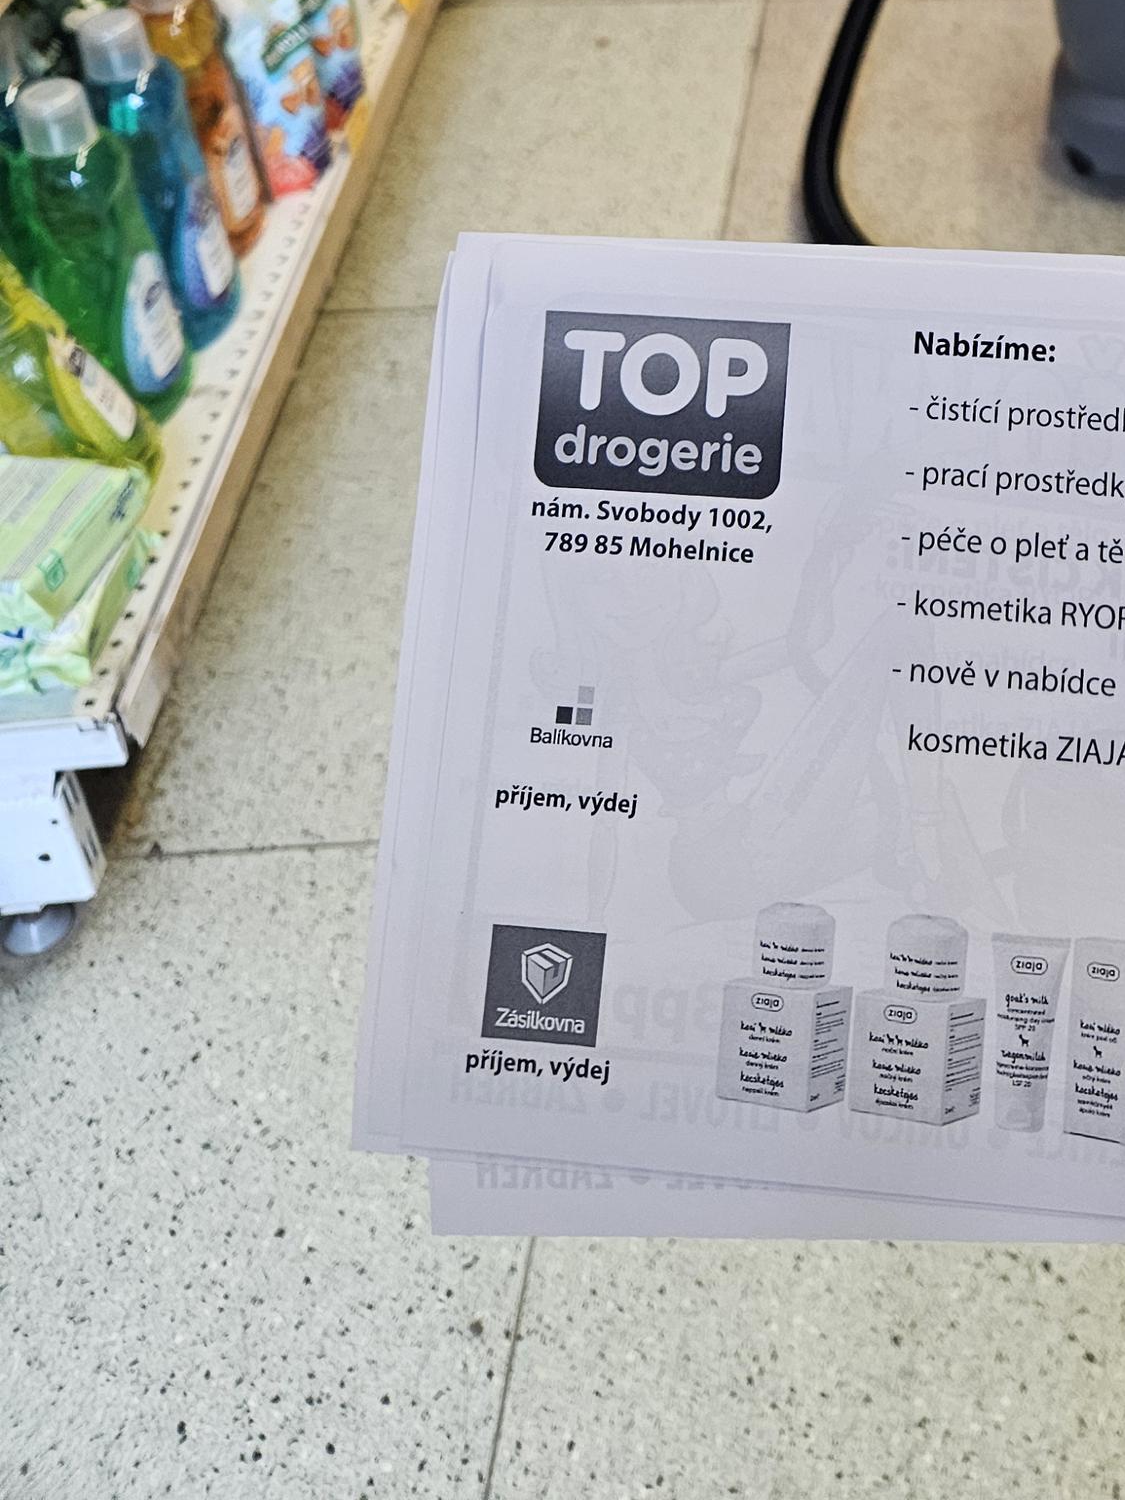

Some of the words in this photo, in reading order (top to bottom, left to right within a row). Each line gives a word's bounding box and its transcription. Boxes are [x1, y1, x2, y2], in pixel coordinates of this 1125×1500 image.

[913, 330, 1056, 363] Nabízíme:
[563, 328, 769, 418] TOP
[926, 395, 1002, 424] čistící
[554, 423, 763, 477] drogerie
[922, 463, 990, 491] prací
[531, 496, 590, 520] nám.
[596, 500, 702, 532] Svobody
[709, 507, 773, 534] 1002,
[544, 531, 589, 554] 789
[594, 534, 623, 556] 85
[629, 536, 754, 564] Mohelnice
[918, 526, 983, 557] péče
[990, 536, 1007, 556] o
[1015, 531, 1070, 564] pleť
[1075, 542, 1089, 562] a
[914, 589, 1052, 625] kosmetika
[909, 660, 976, 687] nově
[984, 668, 1000, 688] v
[1007, 665, 1116, 697] nabídce
[529, 726, 613, 749] Balíkovna
[908, 723, 1048, 761] kosmetika
[494, 784, 572, 812] příjem,
[578, 790, 638, 820] výdej
[493, 1005, 586, 1035] Zásilkovna
[466, 1049, 543, 1076] příjem,
[550, 1057, 609, 1085] výdej
